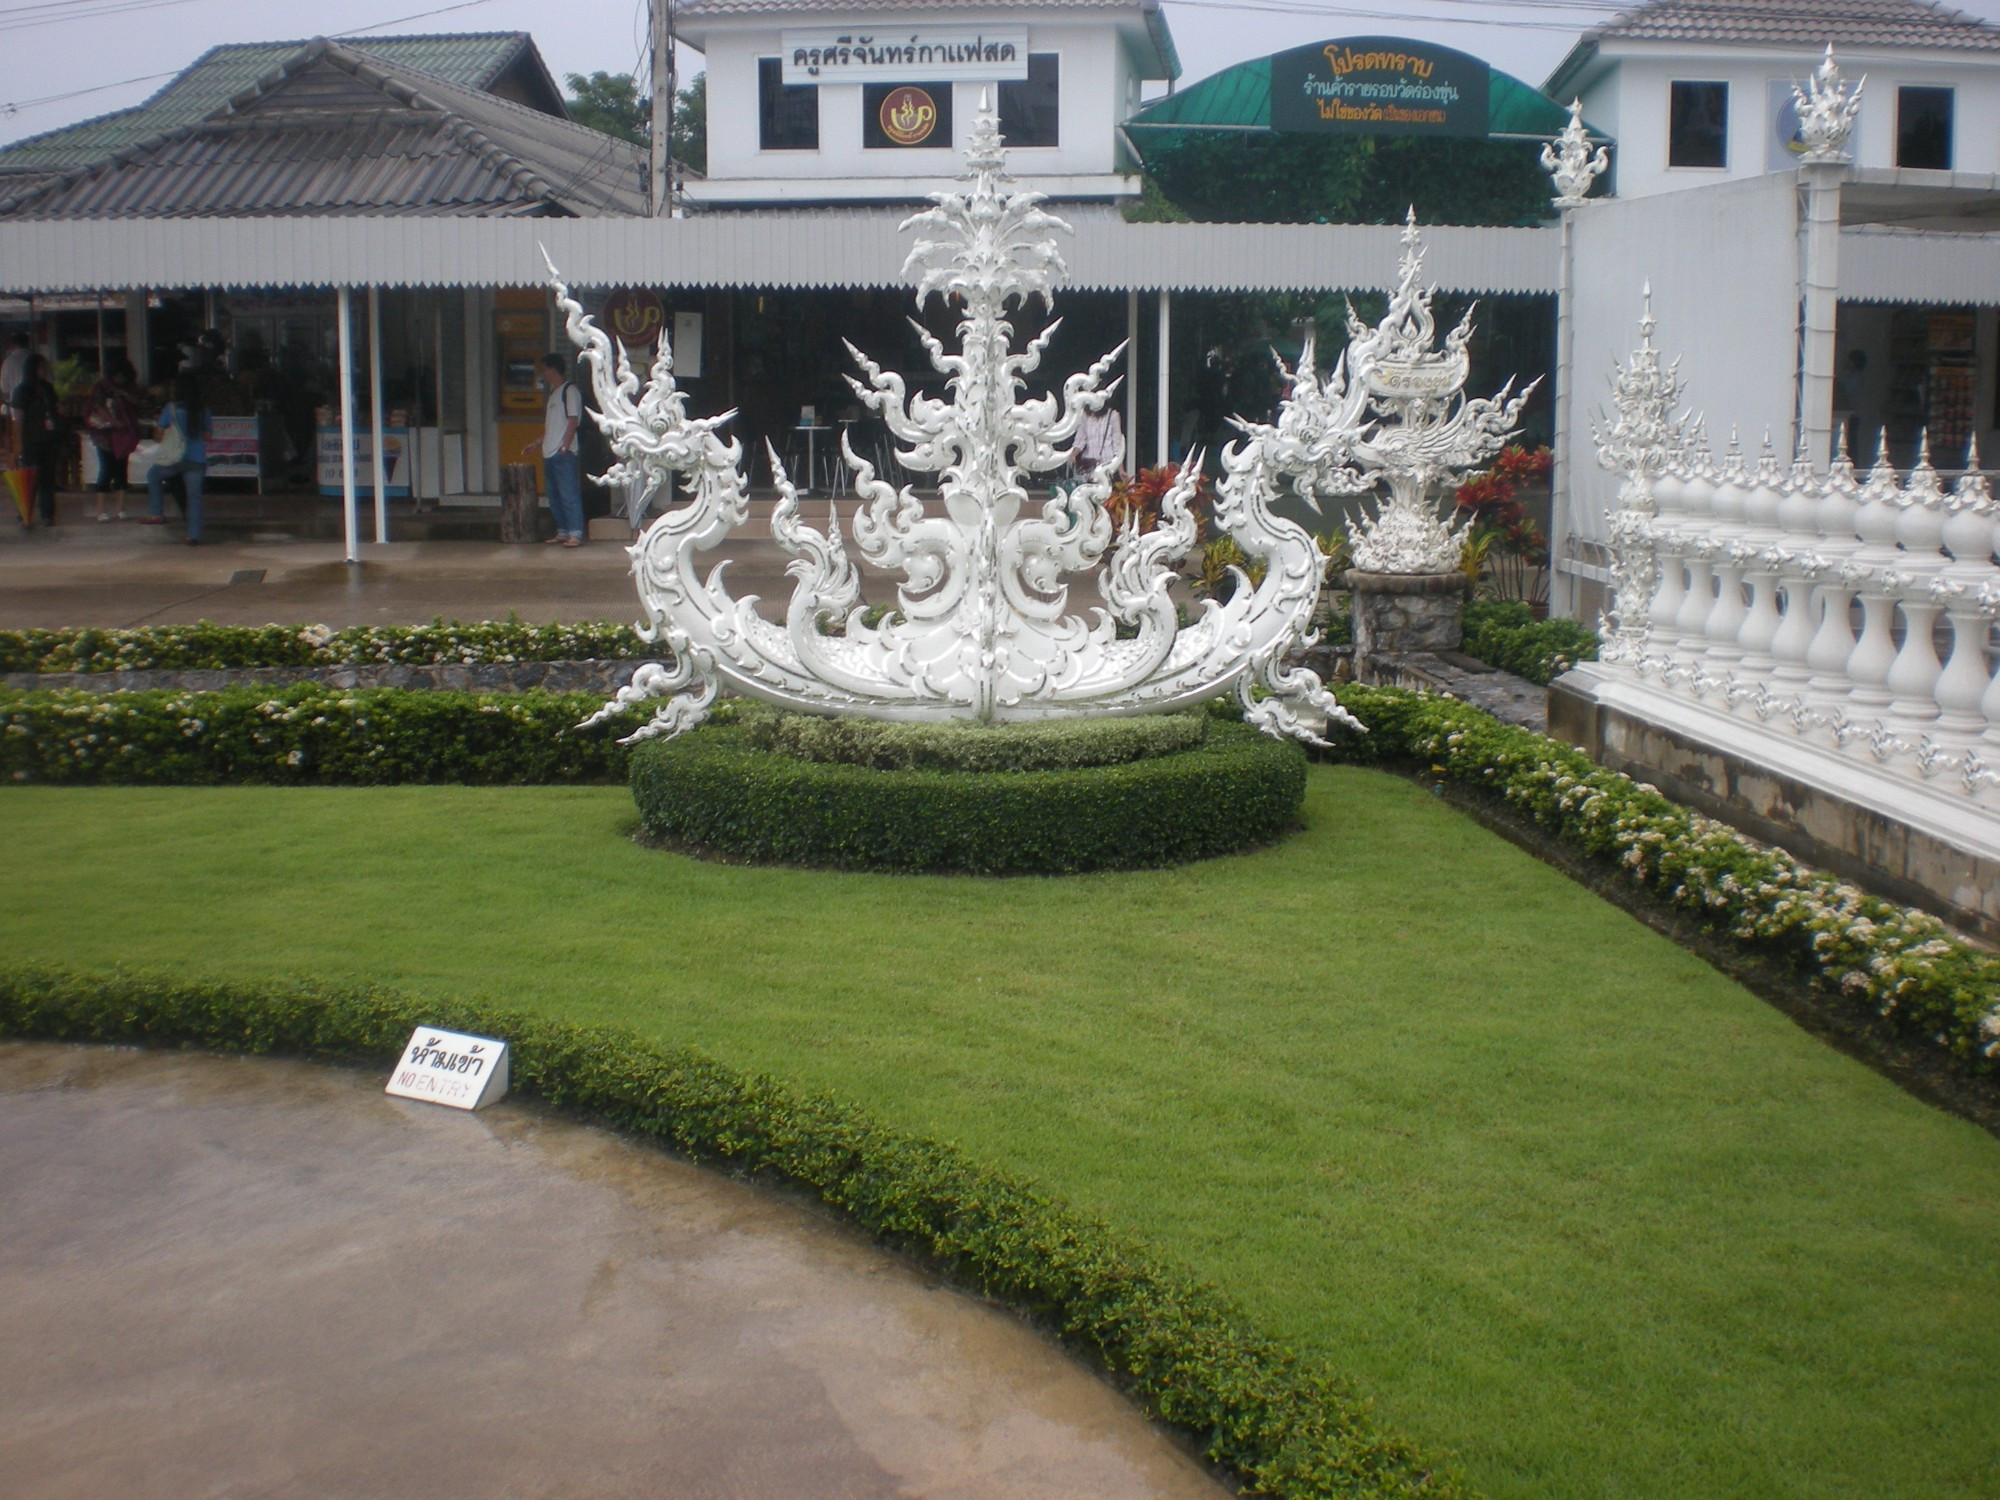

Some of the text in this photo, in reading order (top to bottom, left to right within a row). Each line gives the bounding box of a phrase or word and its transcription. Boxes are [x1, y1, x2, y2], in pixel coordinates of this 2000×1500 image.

[793, 34, 1016, 76] ครูศรีจันทร์กาแฟสด
[1323, 44, 1435, 78] โปรดทราบ
[1303, 73, 1459, 104] ร้านค้ารายรอบวัดร่องขุ่น
[410, 1037, 485, 1076] ห้ามเข้า
[397, 1071, 473, 1098] NO ENTRY
